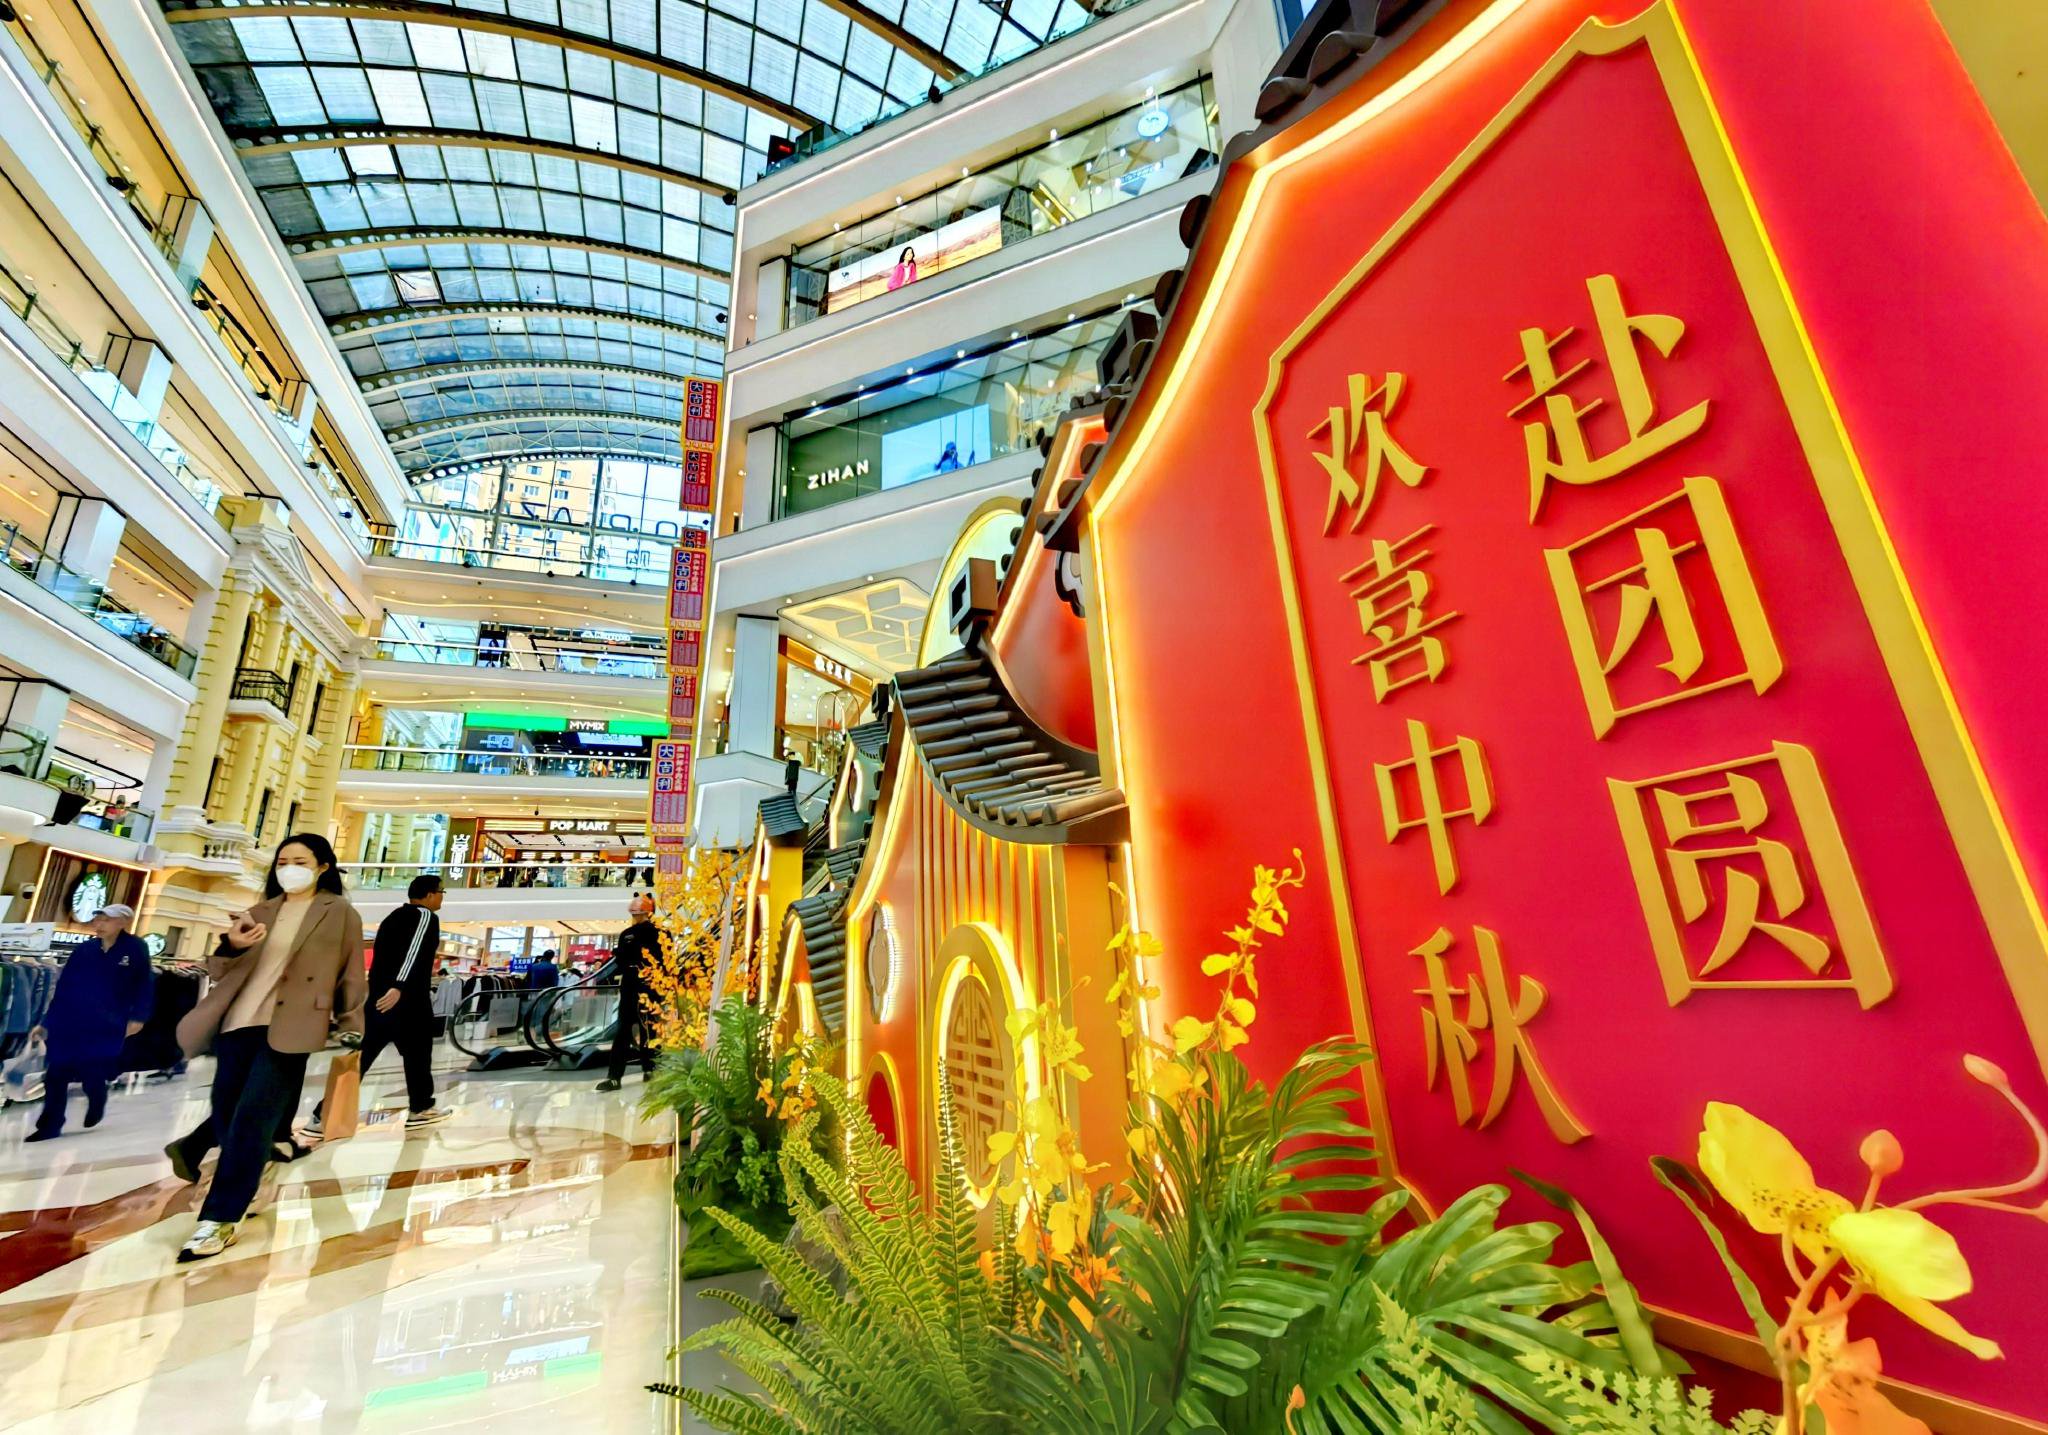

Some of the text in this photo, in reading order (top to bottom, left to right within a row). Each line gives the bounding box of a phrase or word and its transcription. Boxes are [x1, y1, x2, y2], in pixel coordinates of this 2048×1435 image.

[807, 458, 869, 490] ZIHAN
[675, 551, 691, 592] 大吉利
[1503, 274, 1894, 1010] 赴团圆
[569, 720, 605, 731] MYMIX
[656, 743, 675, 792] 大吉利
[1307, 372, 1593, 1145] 欢喜中秋
[550, 821, 610, 831] POP MART
